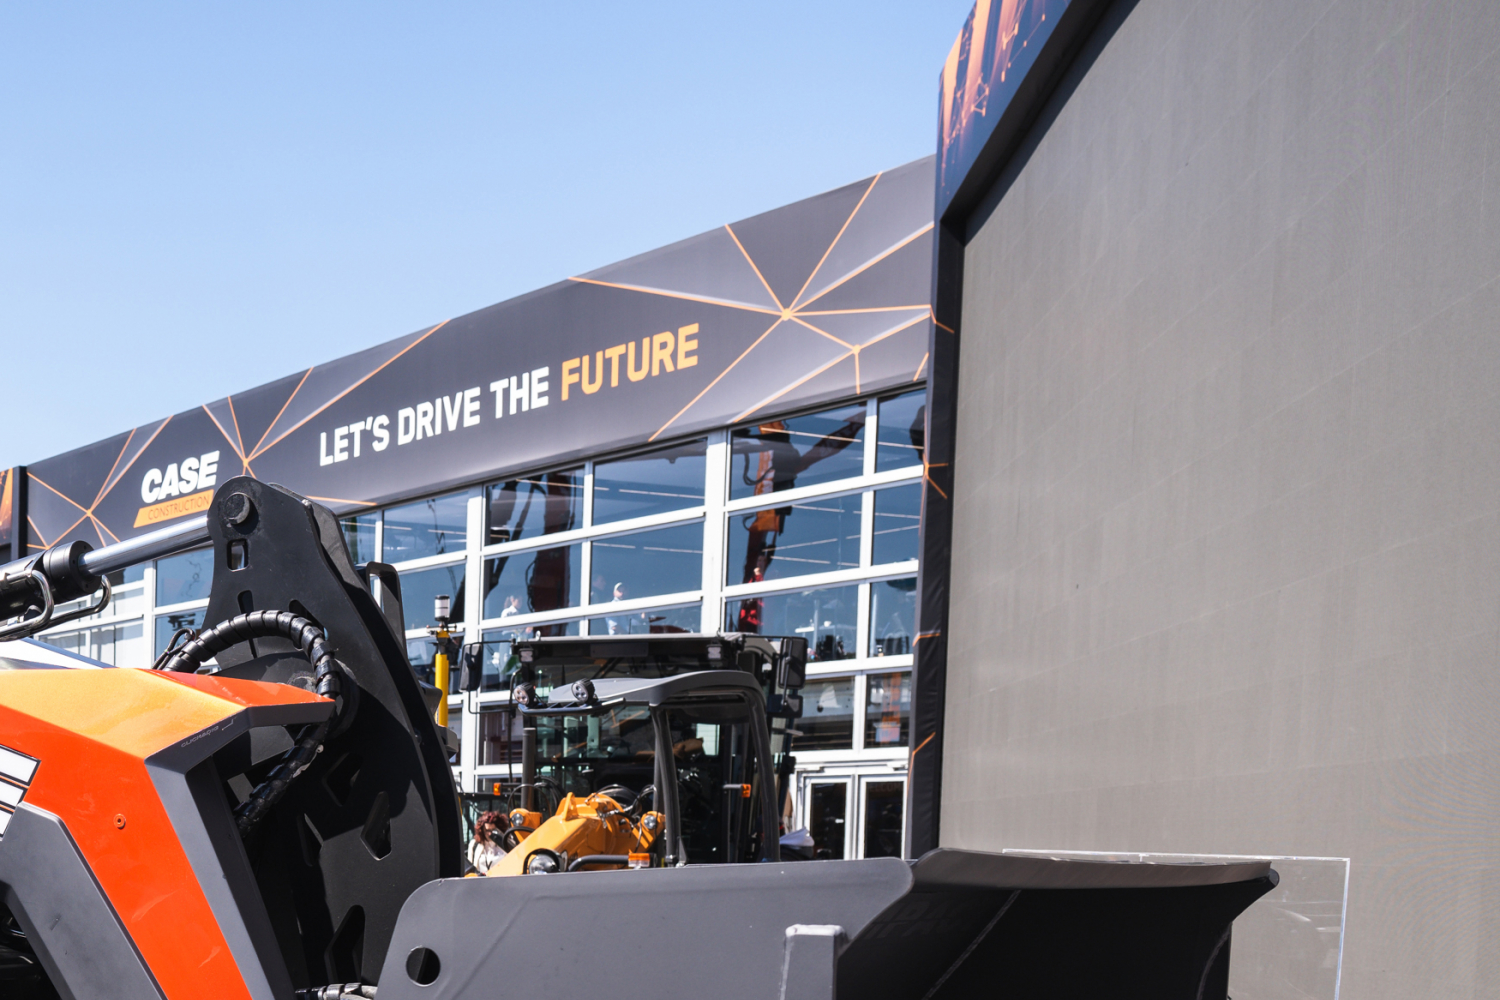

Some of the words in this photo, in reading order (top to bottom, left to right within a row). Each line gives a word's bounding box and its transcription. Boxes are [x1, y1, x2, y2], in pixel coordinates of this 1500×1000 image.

[319, 413, 390, 466] LET'S
[397, 386, 481, 446] DRIVE
[489, 366, 550, 419] THE
[561, 322, 700, 401] FUTURE
[141, 450, 220, 504] CASE
[147, 494, 210, 521] CONSTRUCTION
